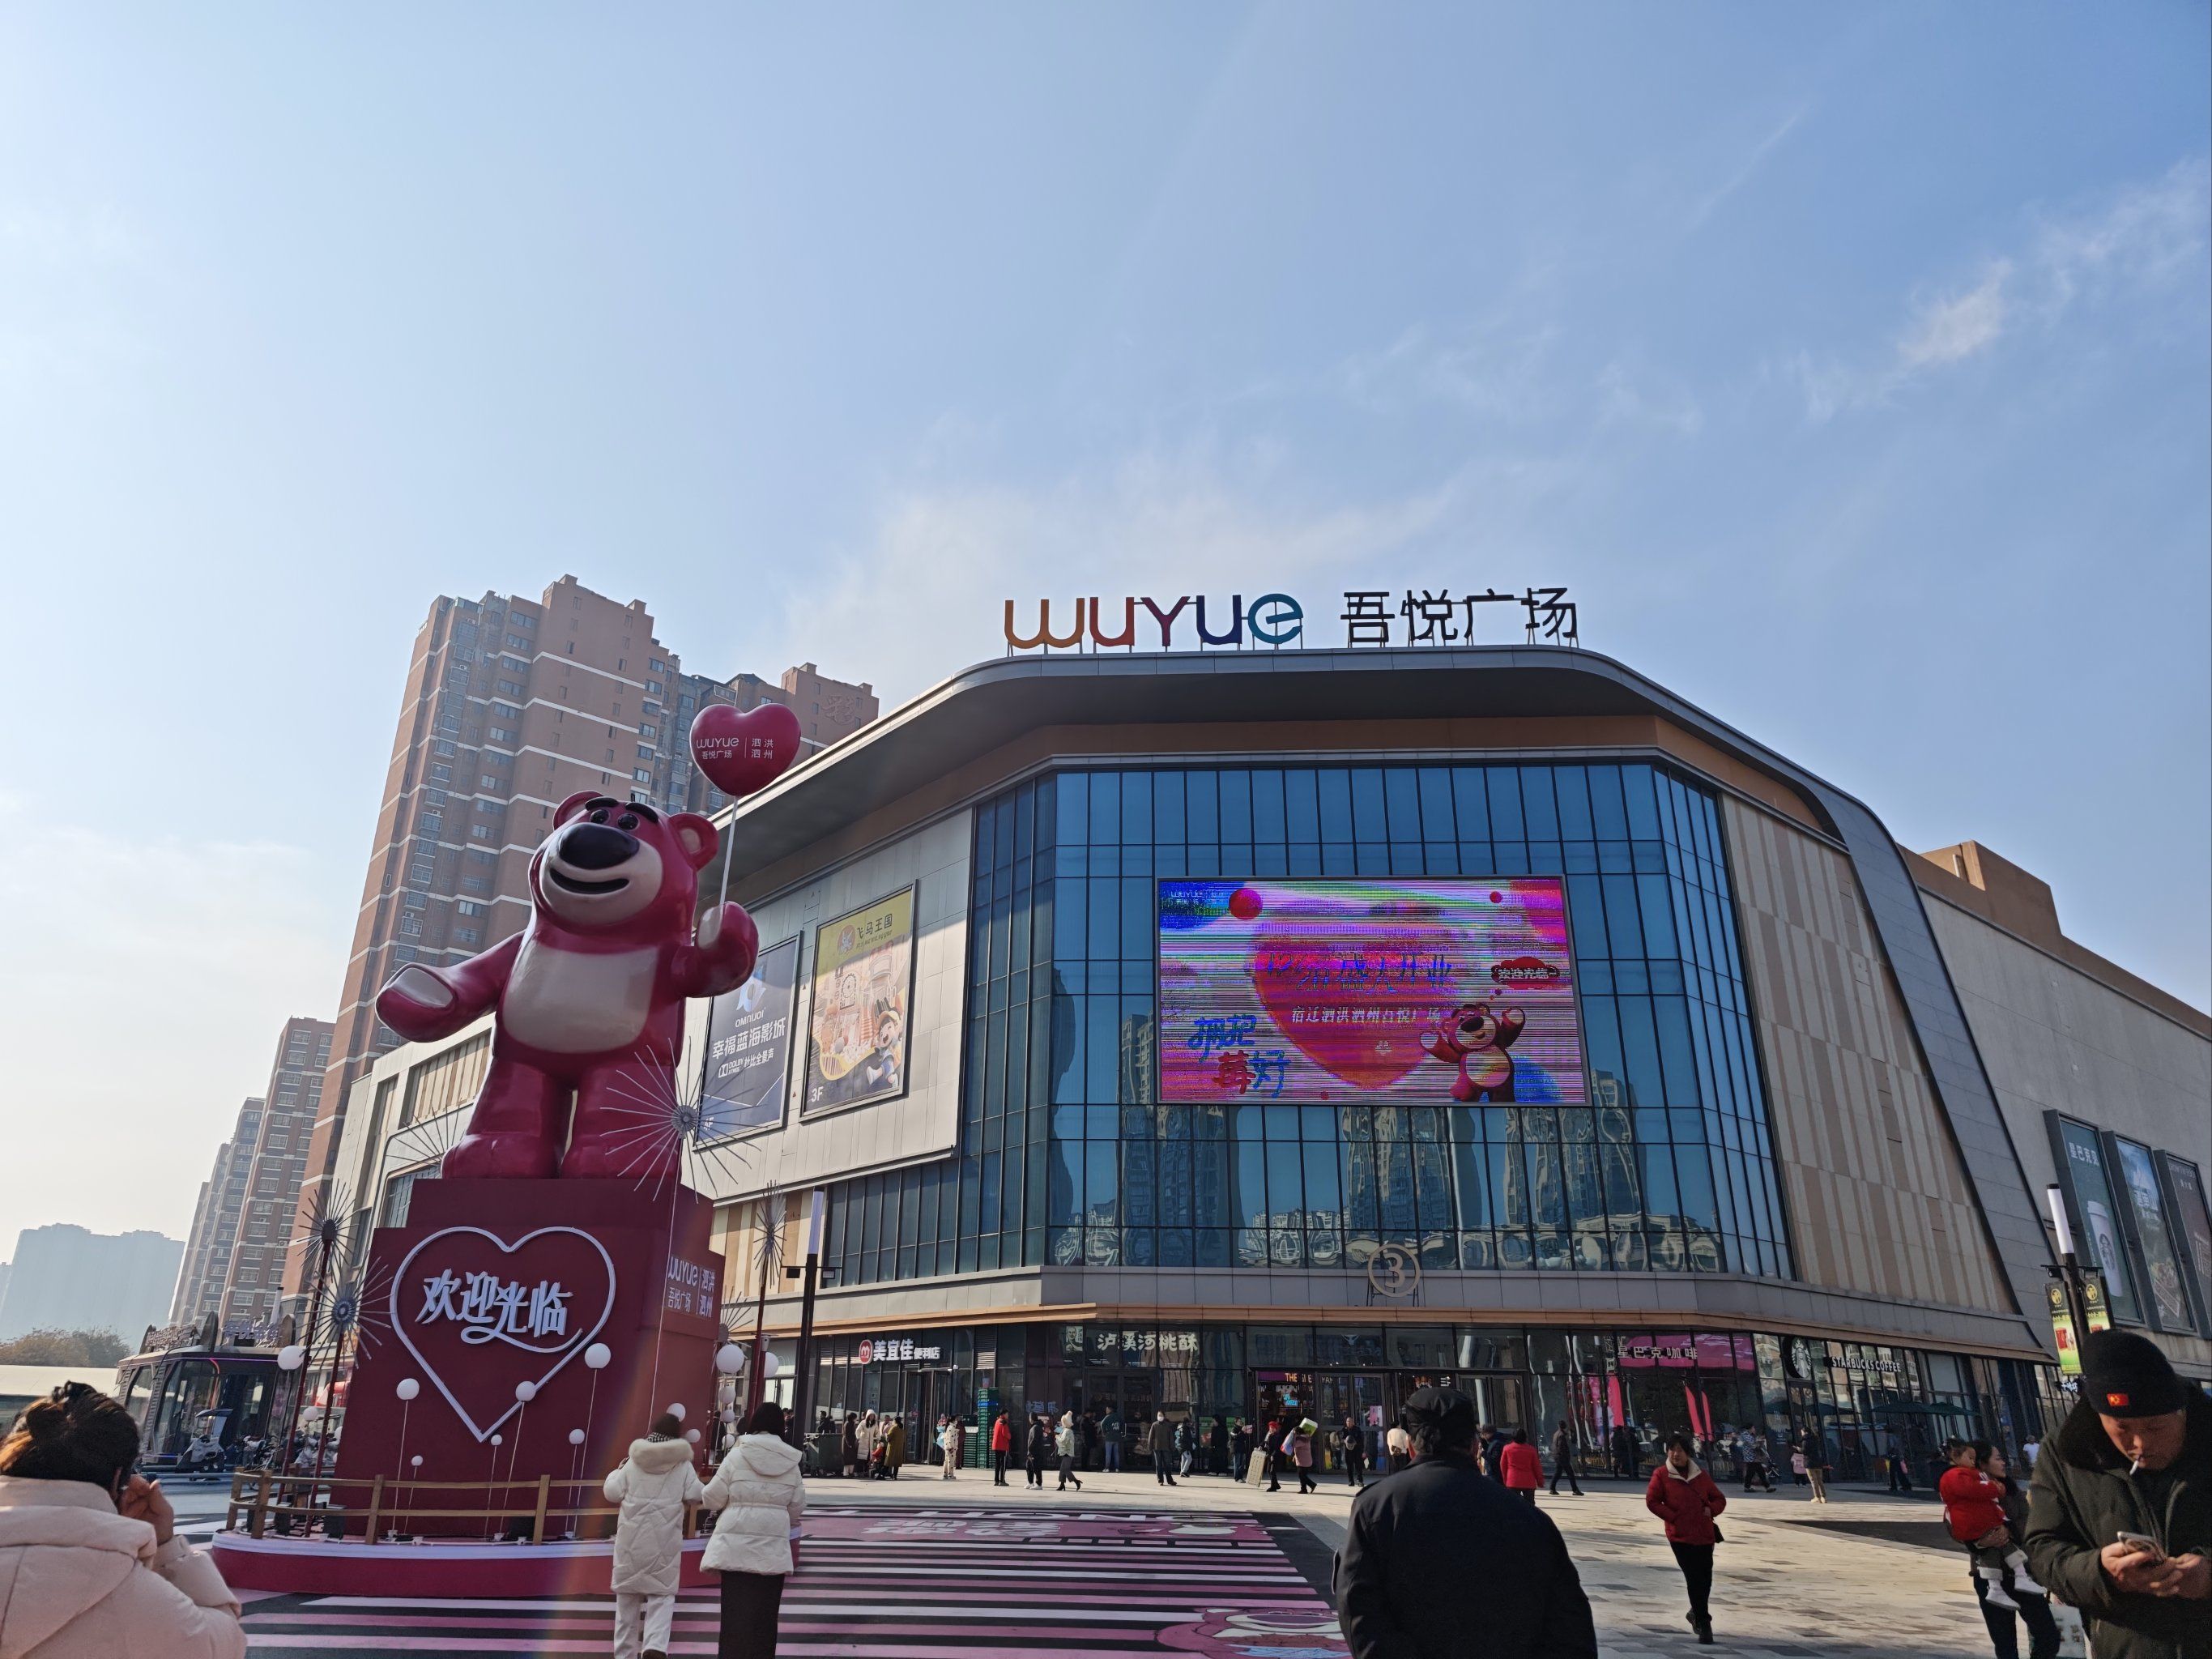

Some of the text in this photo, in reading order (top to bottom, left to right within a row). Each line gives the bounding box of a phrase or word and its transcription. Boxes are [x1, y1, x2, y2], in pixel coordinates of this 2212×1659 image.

[1340, 587, 1577, 643] 吾悦广场
[702, 750, 732, 759] 吾悦广场
[857, 913, 893, 940] 飞马王国
[712, 1016, 786, 1060] 幸福蓝海影城
[744, 1047, 774, 1068] 杜比全景声
[811, 1086, 824, 1102] 3F
[1383, 1252, 1405, 1288] 3
[415, 1268, 573, 1337] 欢迎光临
[667, 1286, 692, 1313] 吾悦广场
[1097, 1333, 1198, 1352] 泸溪河桃酥
[1617, 1346, 1698, 1360] 星巴克咖啡
[1832, 1357, 1902, 1372] STARBUCKS COFFEE
